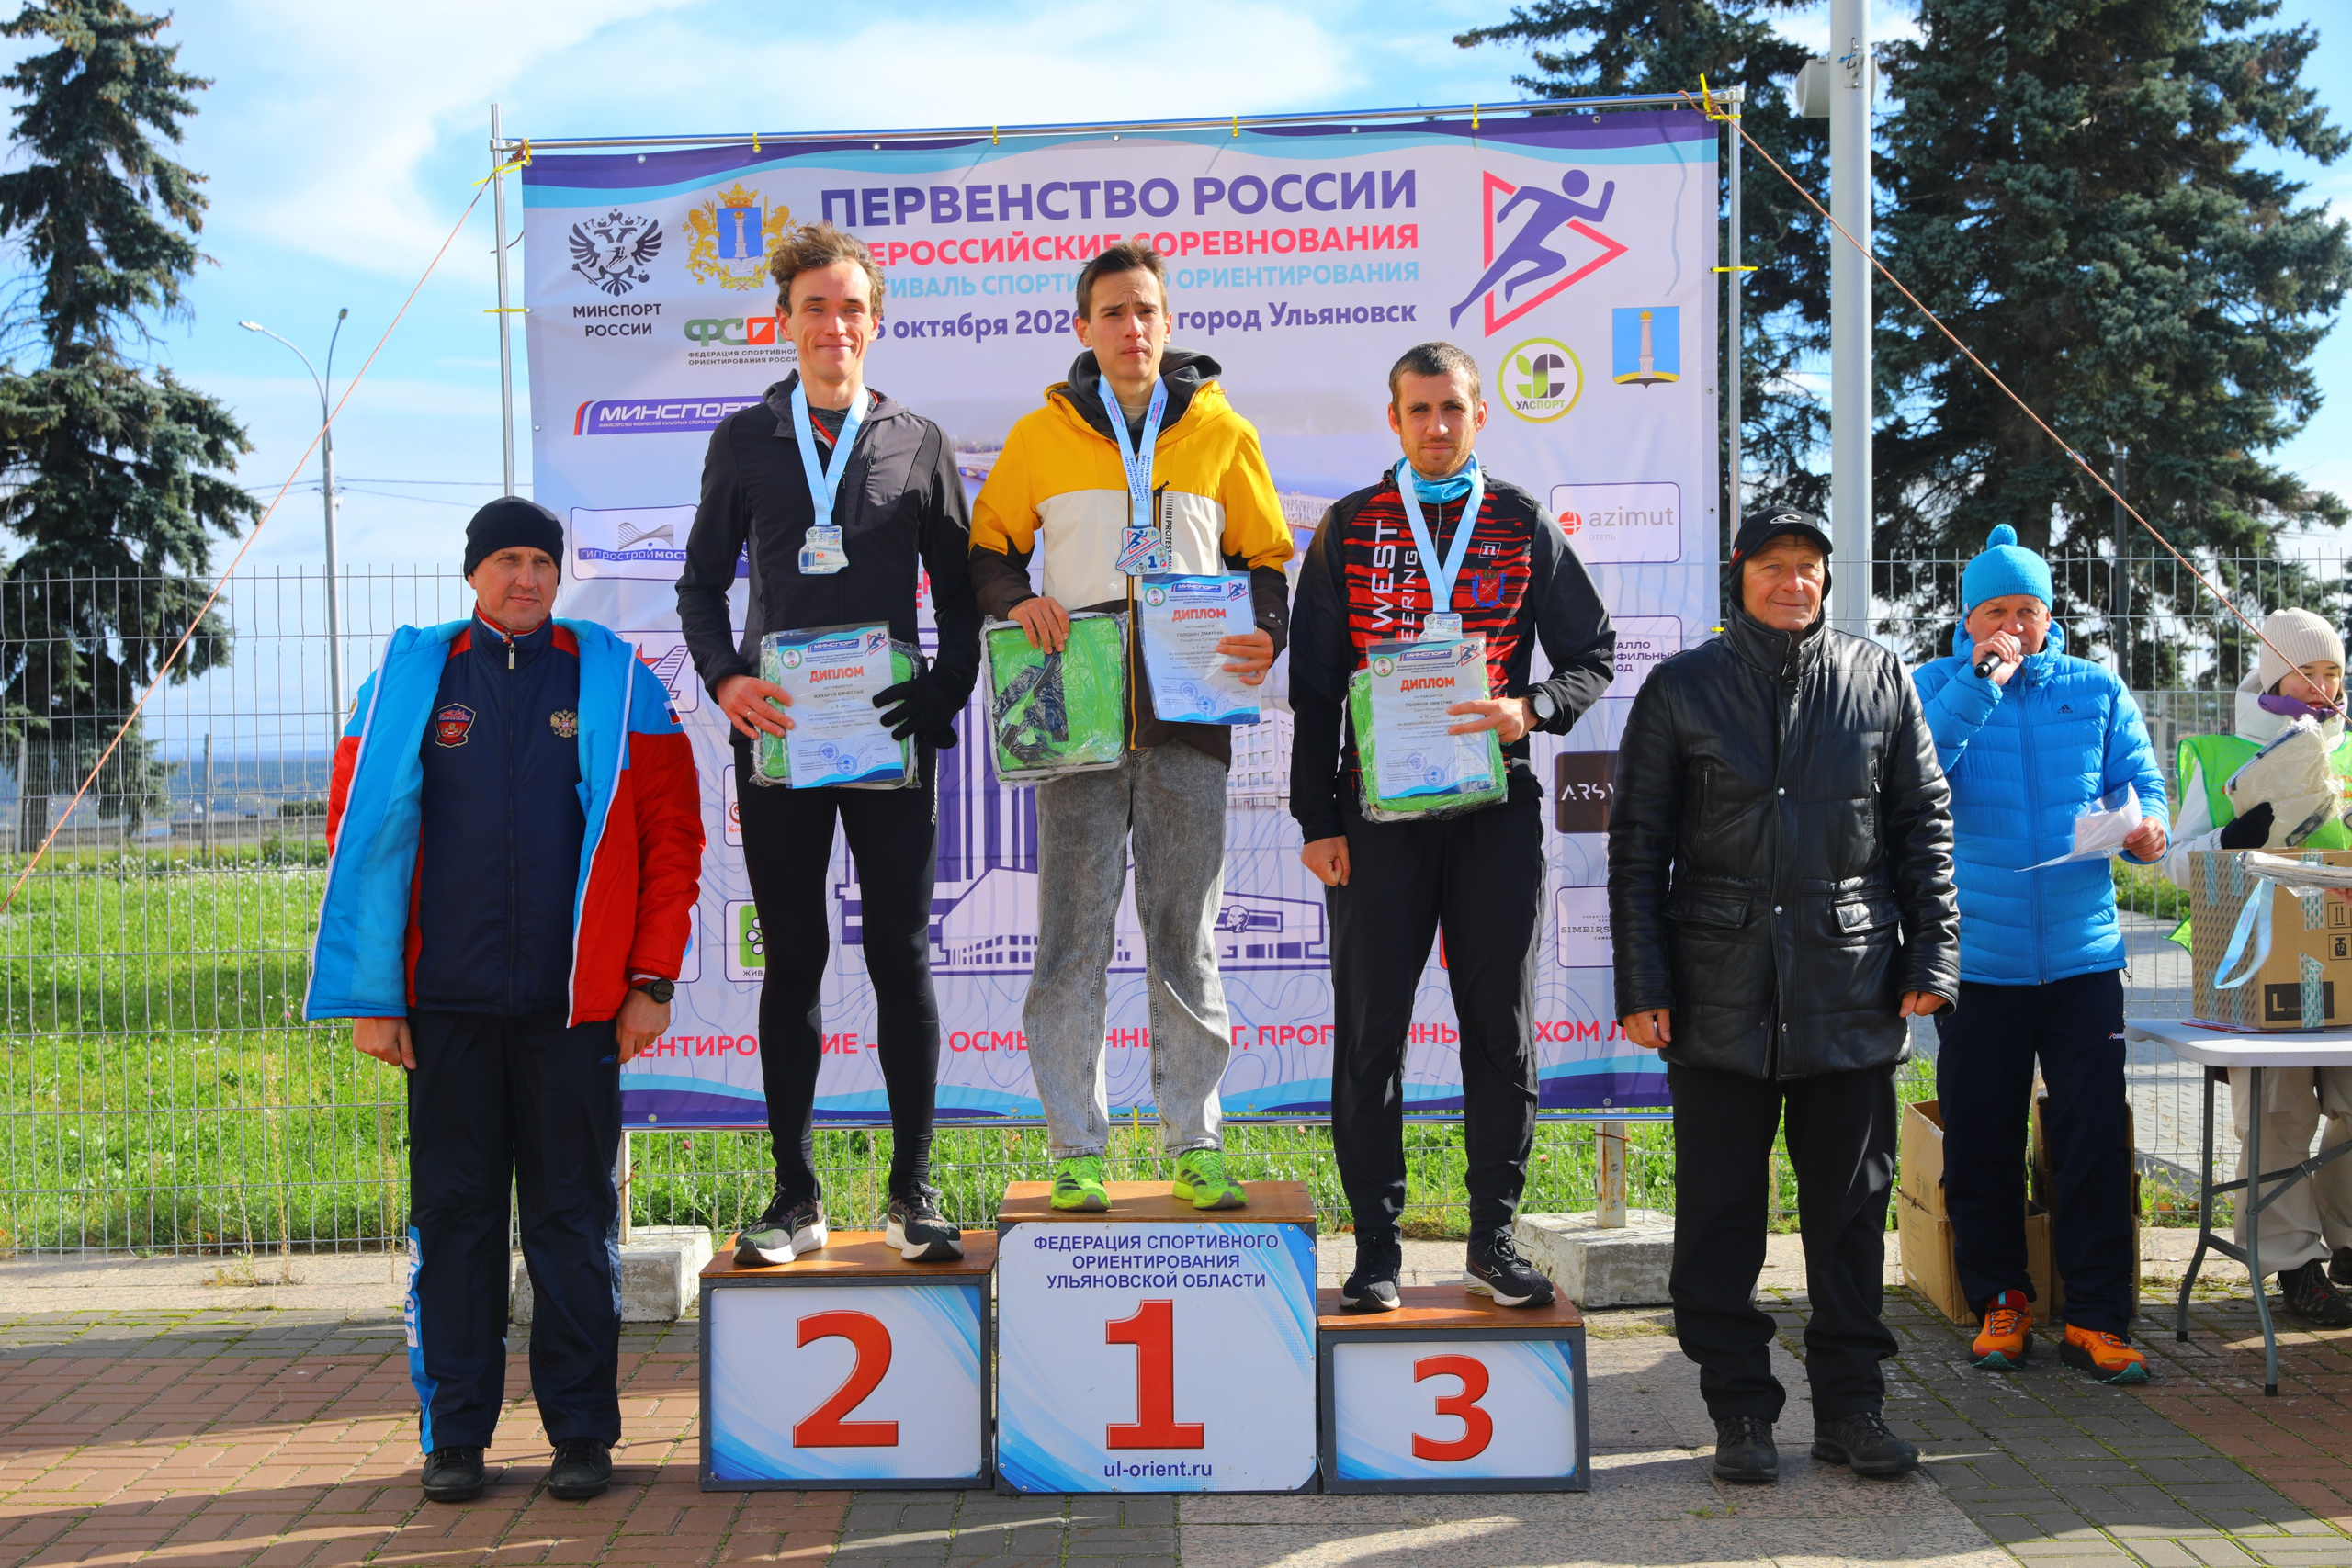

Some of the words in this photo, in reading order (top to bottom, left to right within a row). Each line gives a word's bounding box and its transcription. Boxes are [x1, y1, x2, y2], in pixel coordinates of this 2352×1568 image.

[821, 177, 1179, 227] ПЕРВЕНСТВО
[1193, 169, 1417, 216] РОССИИ
[867, 230, 1122, 266] ЕРОССИЙСКИЕ
[883, 275, 976, 299] ИВАЛЬ
[1176, 261, 1419, 289] ОРИЕНТИРОВАНИЯ
[572, 303, 662, 319] МИНСПОРТ
[585, 322, 652, 337] РОССИИ
[893, 312, 1008, 344] октября
[1015, 309, 1080, 335] 202
[1177, 309, 1261, 336] город
[1268, 301, 1417, 327] Ульяновск
[688, 351, 740, 359] ФЕДЕРАЦИЯ
[741, 348, 797, 356] СПОРТИВНОГ
[688, 357, 767, 366] ОРИЕНТИРОВАНИЯ
[1516, 399, 1566, 410] УЛСПОРТ
[1589, 506, 1675, 527] azimut
[1148, 555, 1158, 569] 1
[1372, 519, 1398, 628] WEST
[1171, 608, 1227, 622] ДИПЛОМ
[1613, 650, 1677, 660] ФИЛЬНЫ
[809, 666, 864, 683] ДИПЛОМ
[1400, 676, 1455, 693] ДИПЛОМ
[743, 969, 764, 977] ЖИВ
[2272, 993, 2285, 1012] L
[1534, 1021, 1600, 1043] ХОМ
[1034, 1235, 1142, 1252] ФЕДЕРАЦИЯ
[1147, 1235, 1279, 1250] СПОРТИВНОГО
[1072, 1255, 1240, 1269] ОРИЕНТИРОВАНИЯ
[1046, 1271, 1178, 1289] УЛЬЯНОВСКОЙ
[1182, 1273, 1267, 1288] ОБЛАСТИ
[793, 1309, 899, 1449] 2
[1105, 1298, 1204, 1450] 1
[1411, 1353, 1494, 1462] 3
[1103, 1461, 1213, 1478] ul-orient.ru
